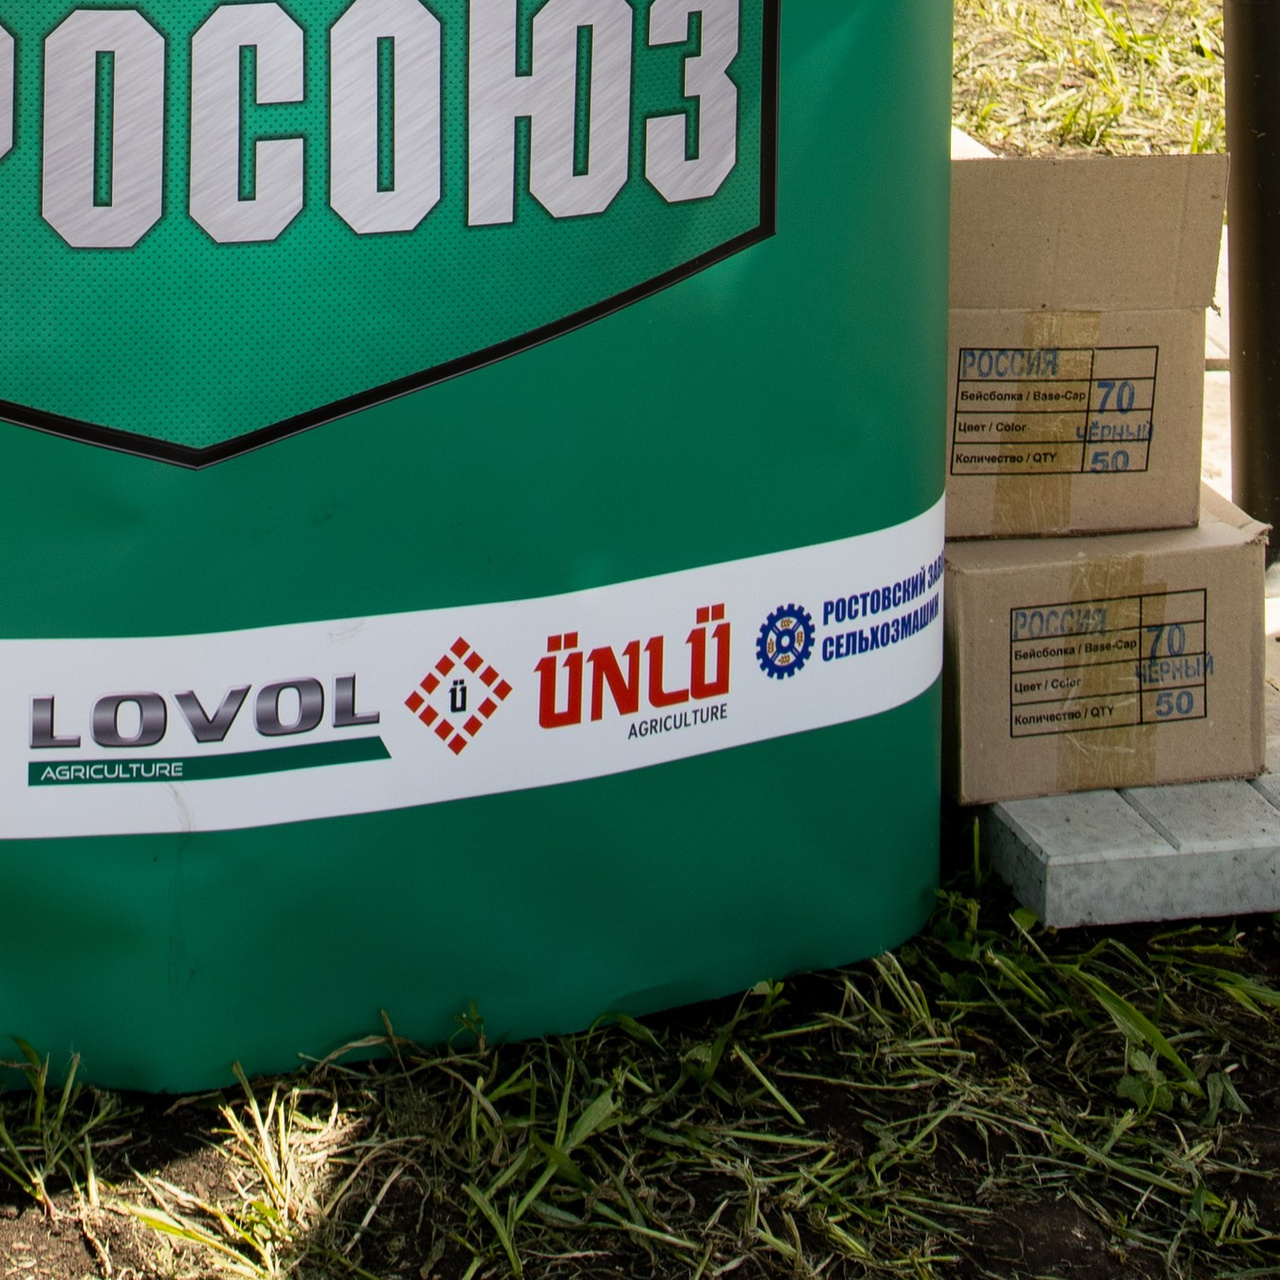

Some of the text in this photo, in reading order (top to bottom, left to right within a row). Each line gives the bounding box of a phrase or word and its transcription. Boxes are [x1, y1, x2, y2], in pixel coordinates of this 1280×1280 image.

[962, 349, 1059, 378] РОССИЯ
[960, 391, 1023, 402] Бейсболка
[1033, 391, 1086, 402] Base-Cap
[1096, 380, 1136, 415] 70
[958, 423, 986, 434] Цвет
[996, 422, 1027, 433] Color
[956, 453, 1024, 465] Количество
[1033, 452, 1057, 464] QTY
[1090, 450, 1130, 474] 50
[823, 564, 926, 626] РОСТОВСКИЙ
[821, 592, 940, 662] СЕЛЬХОЗМАШИН
[1013, 608, 1108, 640] РОССИЯ
[1014, 646, 1075, 661] Бейсболка
[1085, 639, 1138, 653] Base-Cap
[1147, 624, 1186, 665] 70
[533, 602, 731, 730] ÜNLÜ
[1014, 683, 1042, 695] Цвет
[1051, 678, 1082, 689] Color
[28, 671, 381, 750] LOVOL
[1014, 711, 1082, 725] Количество
[1090, 706, 1114, 718] QTY
[1155, 691, 1194, 718] 50
[626, 702, 729, 741] AGRICULTURE
[40, 761, 184, 781] AGRICULTURE
